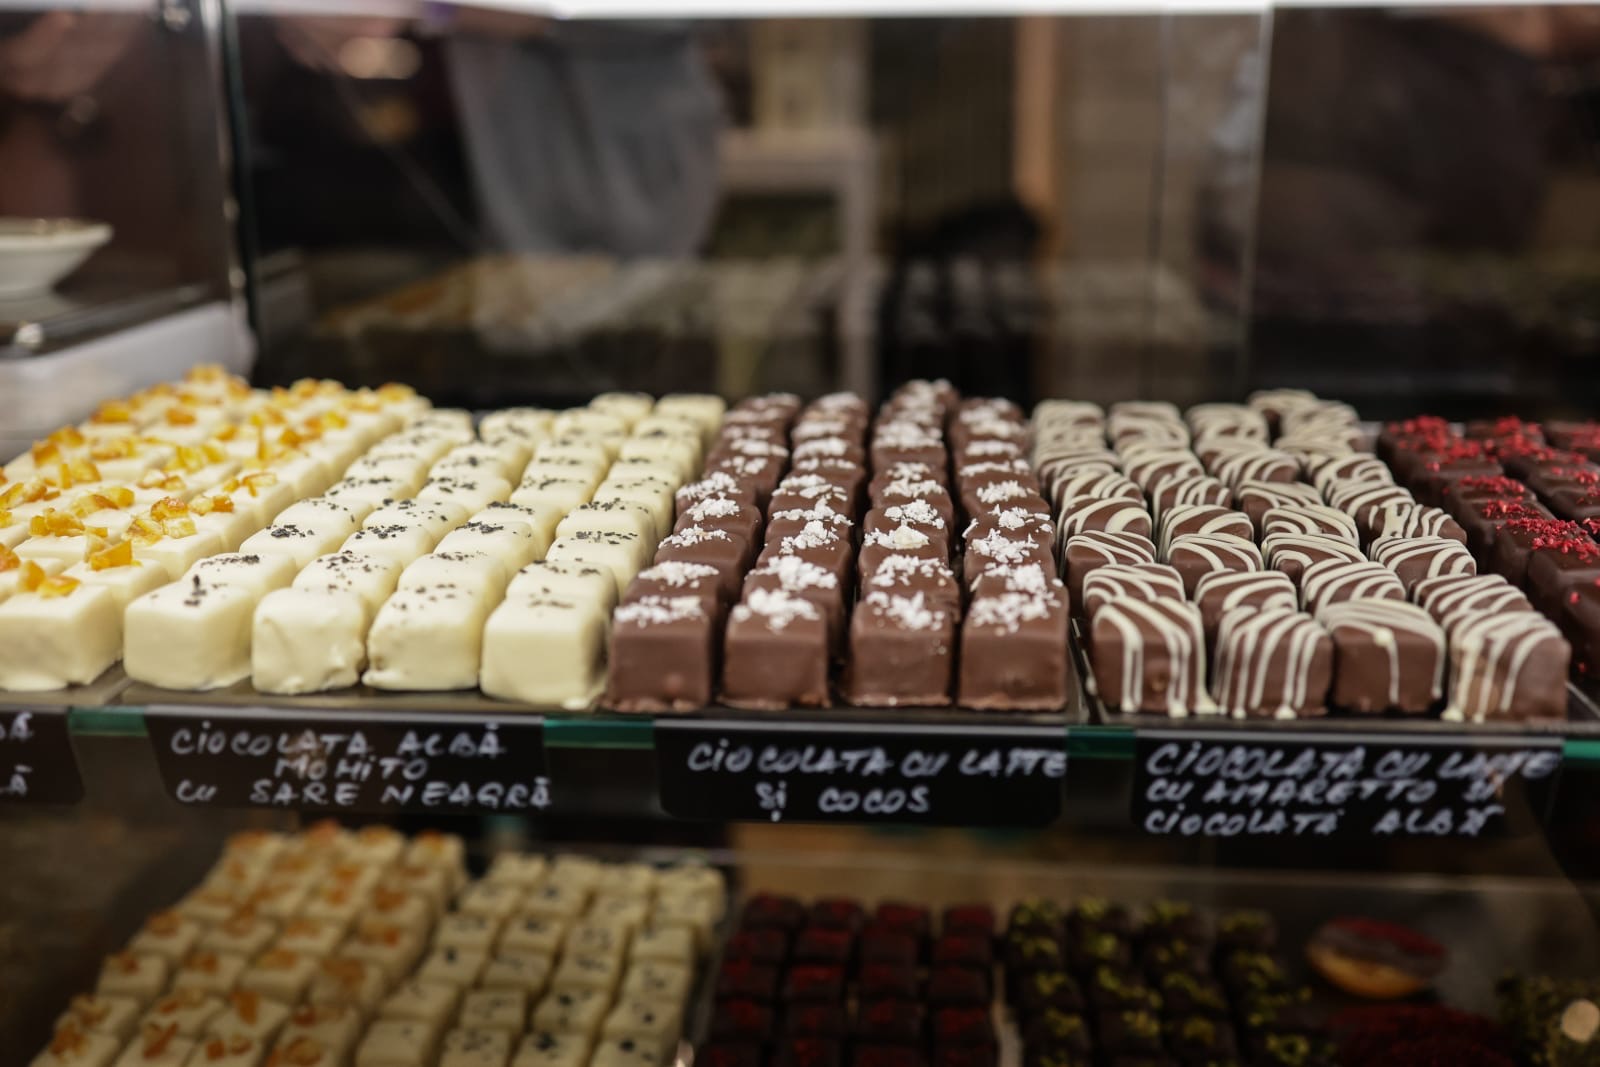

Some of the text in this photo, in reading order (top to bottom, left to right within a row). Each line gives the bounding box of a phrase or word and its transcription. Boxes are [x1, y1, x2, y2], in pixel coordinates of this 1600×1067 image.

[249, 779, 360, 805] SARE
[818, 786, 929, 814] COCOS
[1203, 778, 1437, 806] AMARETTO
